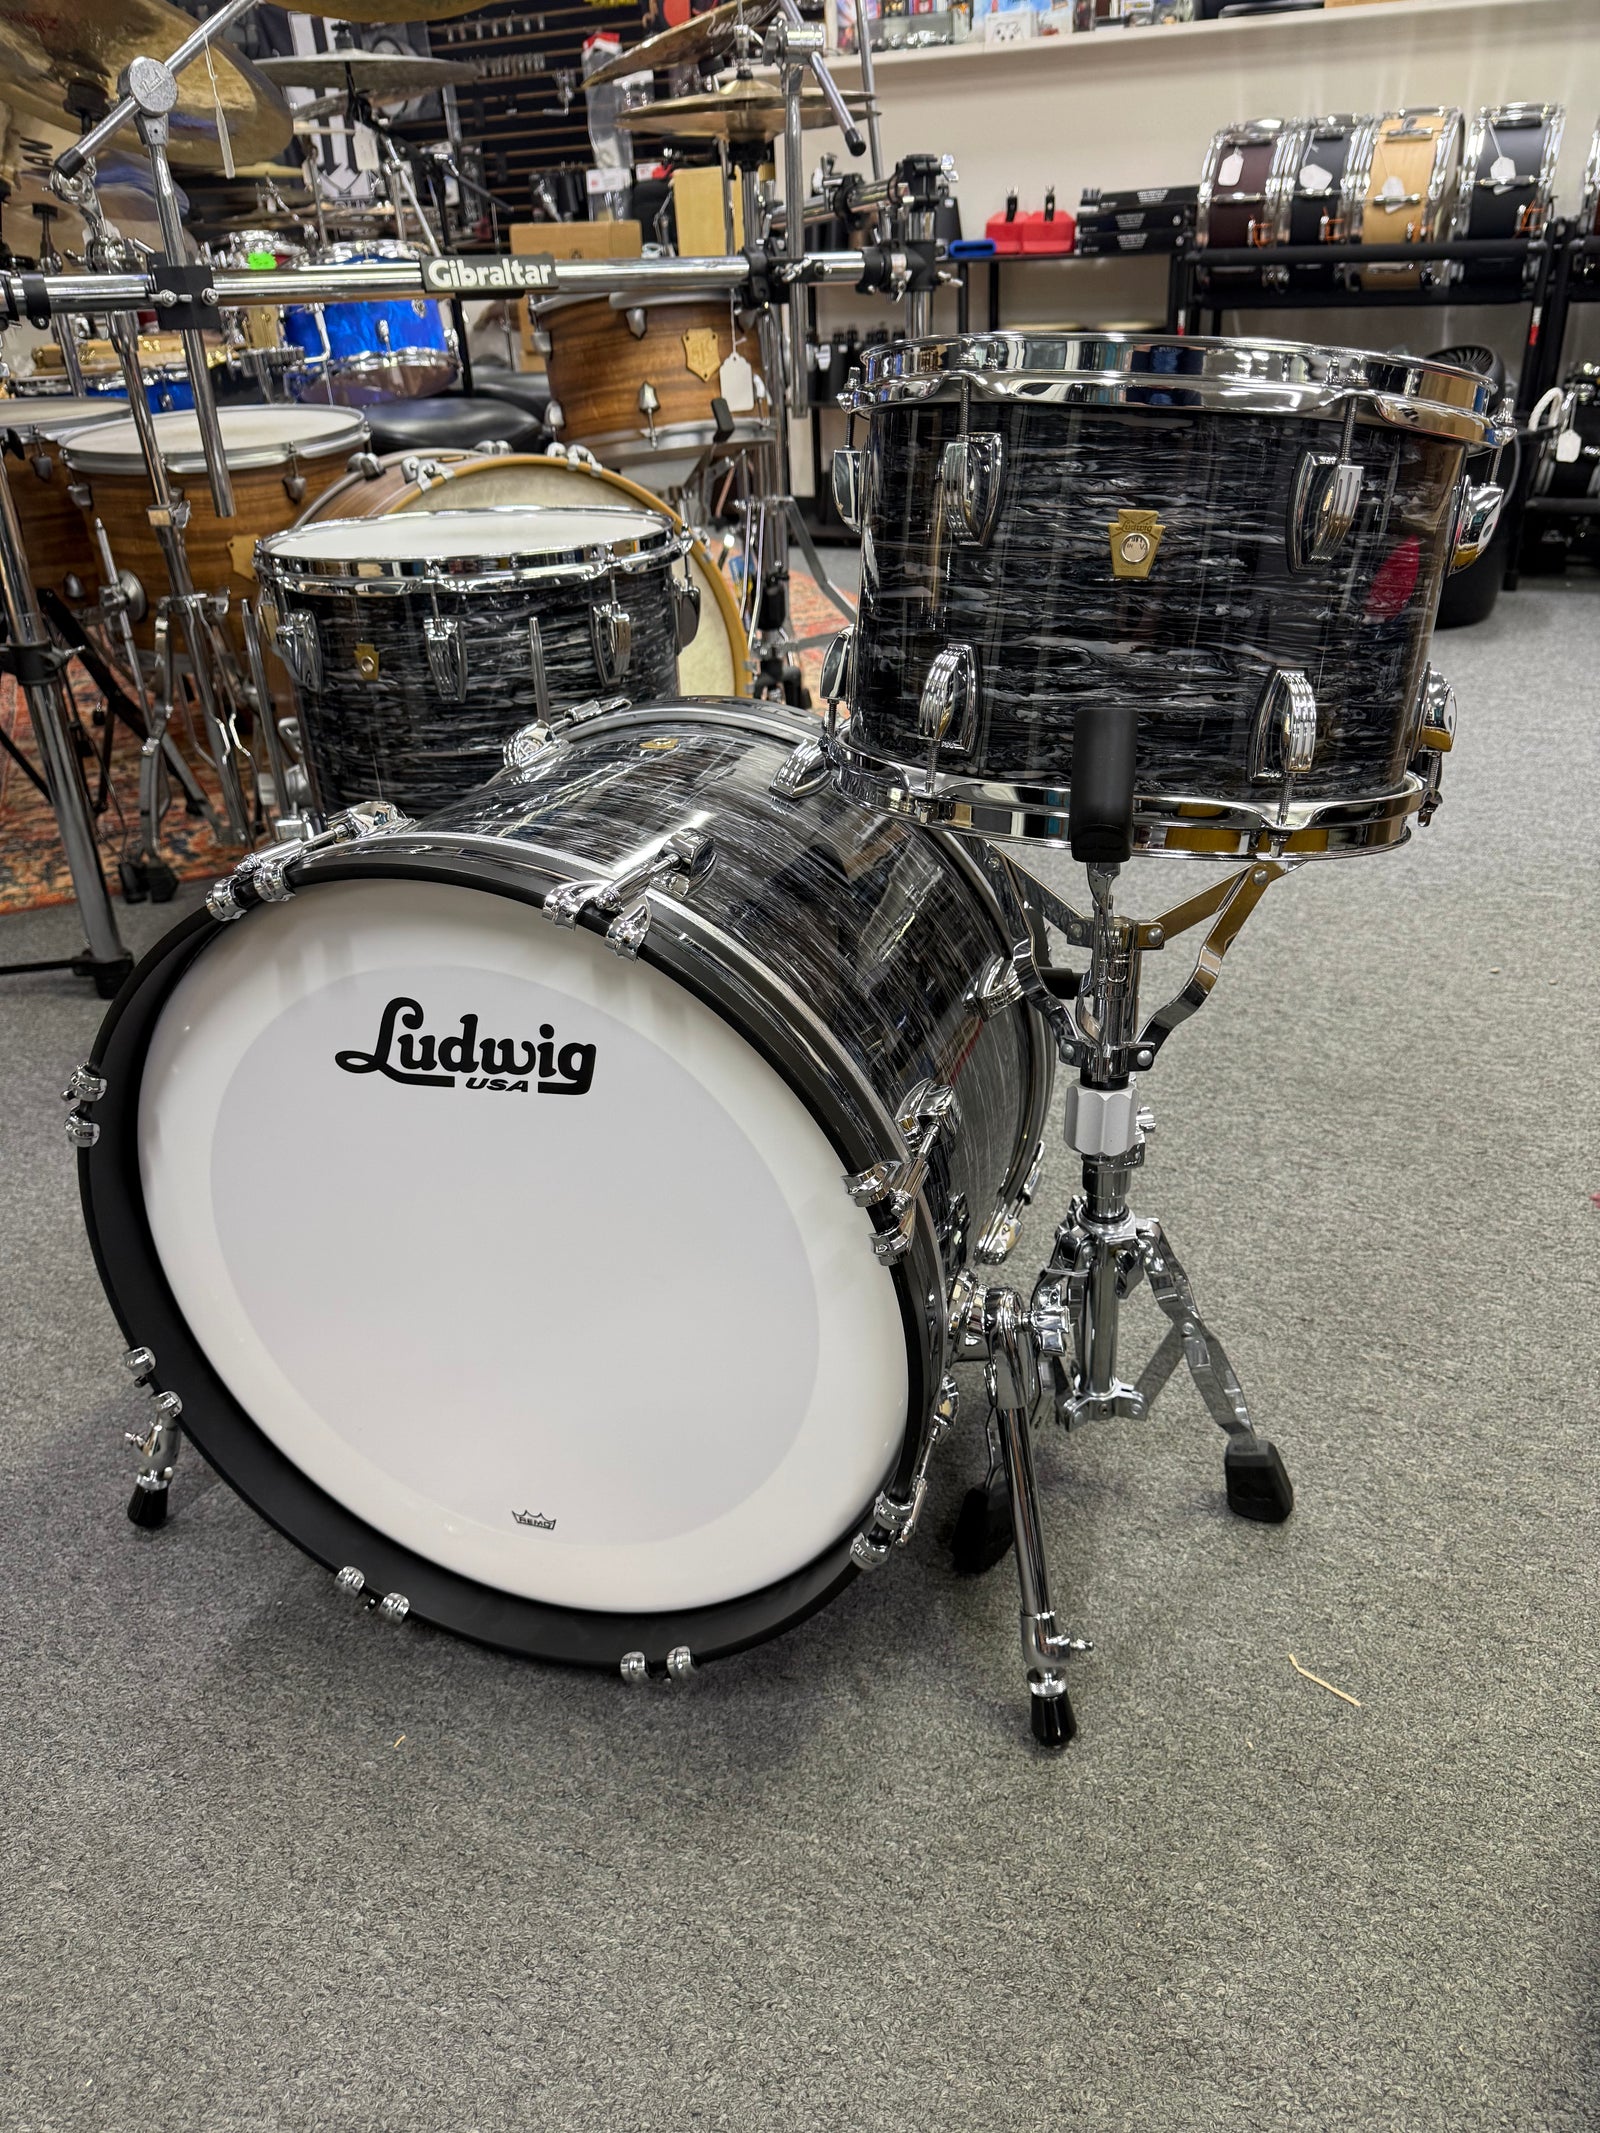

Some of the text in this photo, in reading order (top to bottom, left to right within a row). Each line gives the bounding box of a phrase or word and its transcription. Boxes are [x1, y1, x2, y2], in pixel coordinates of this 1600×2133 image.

[428, 258, 552, 288] Gibraltar
[1115, 519, 1153, 533] Ludwig
[335, 997, 597, 1096] Ludwig
[465, 1077, 529, 1093] USA
[519, 1516, 551, 1529] REMO
